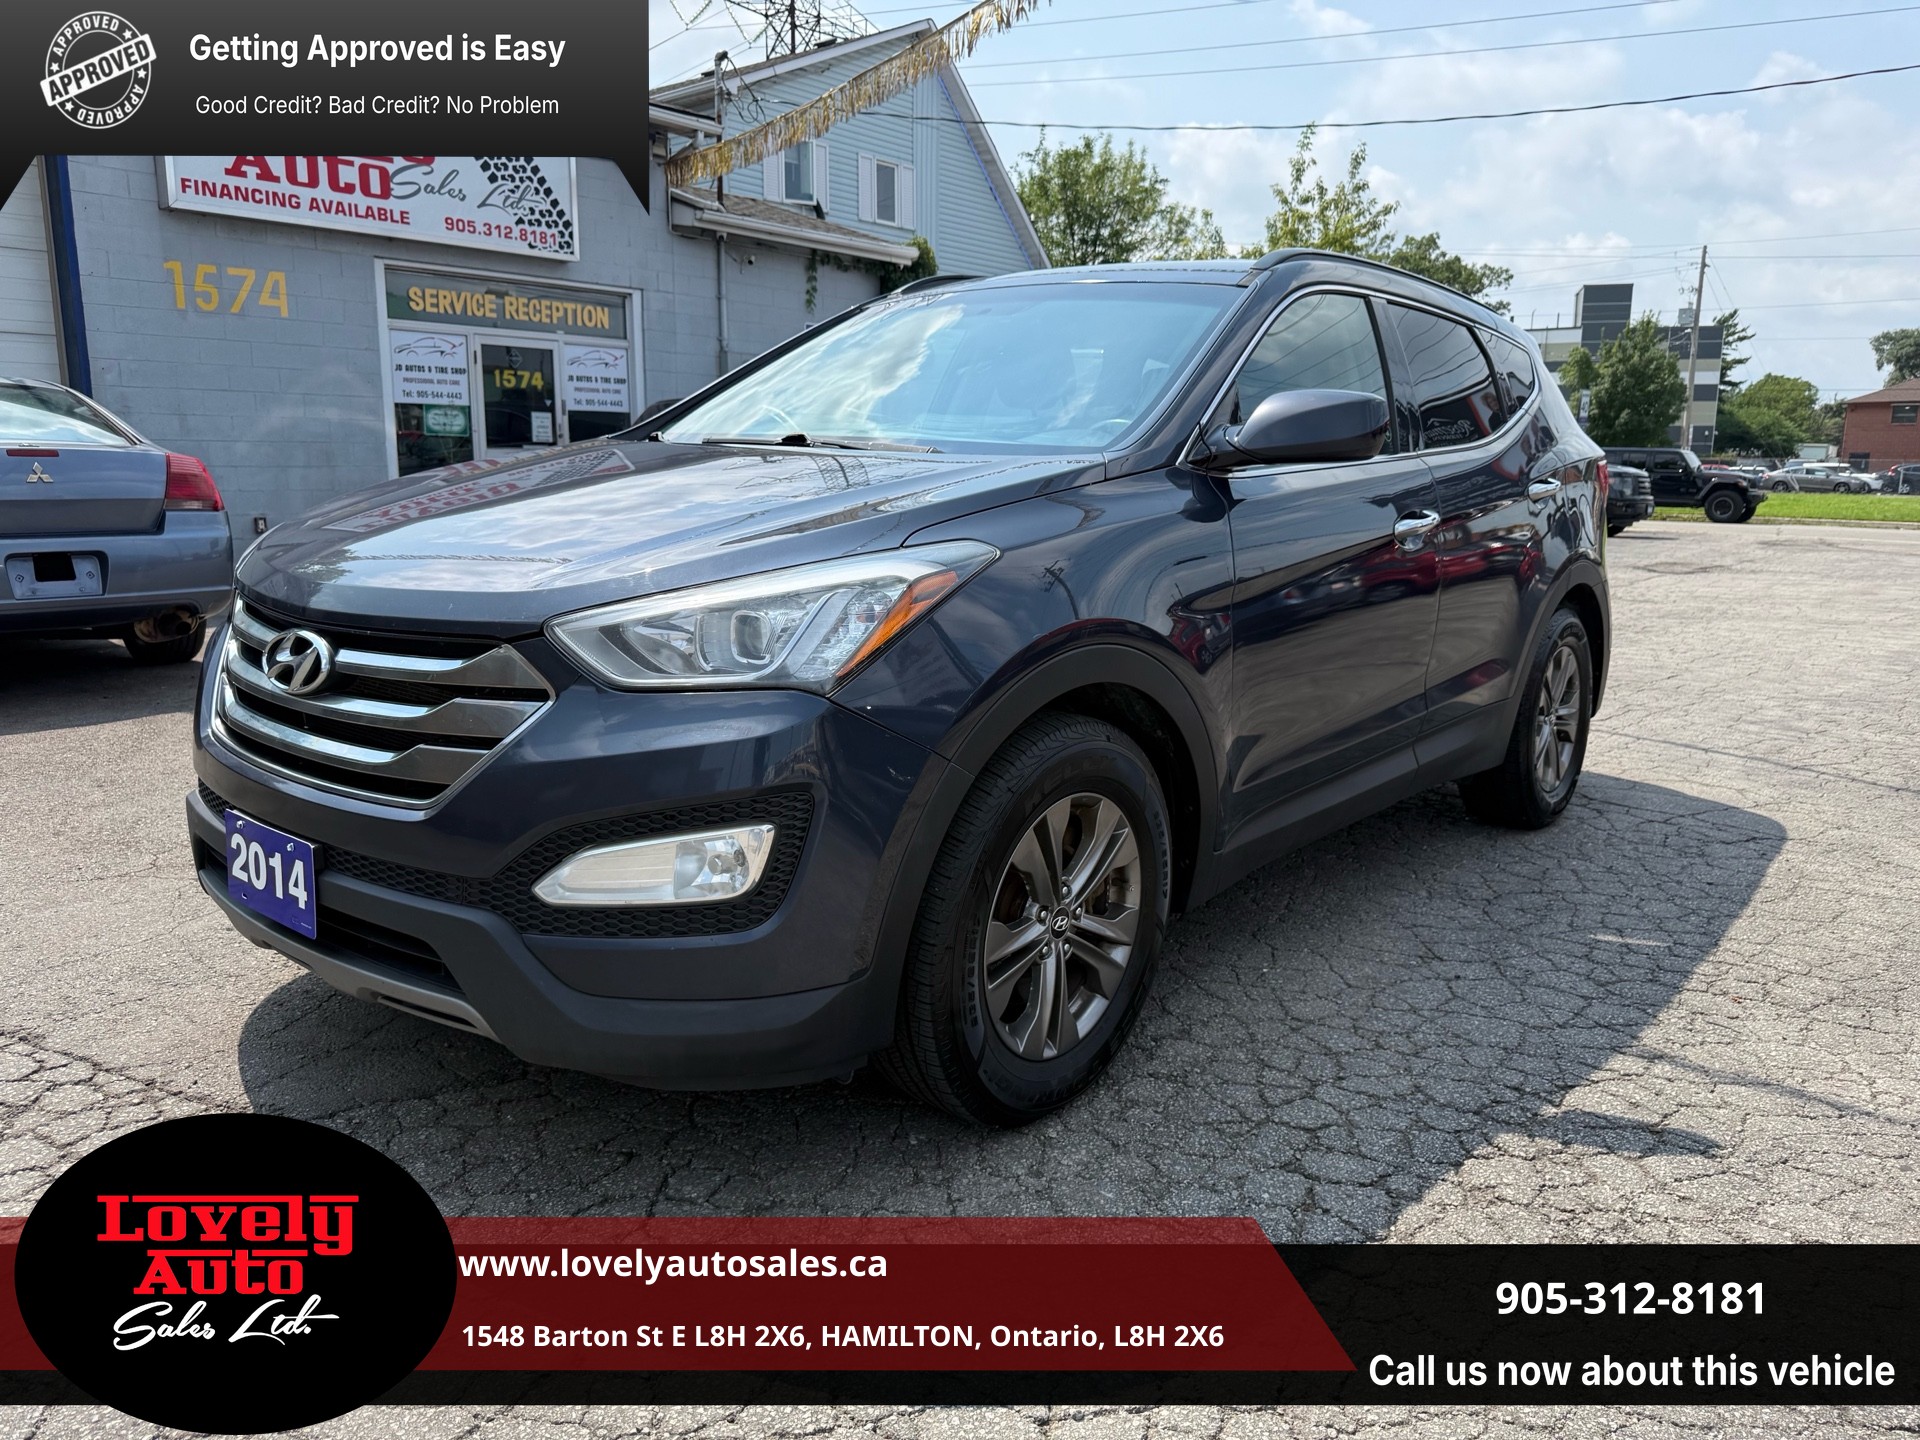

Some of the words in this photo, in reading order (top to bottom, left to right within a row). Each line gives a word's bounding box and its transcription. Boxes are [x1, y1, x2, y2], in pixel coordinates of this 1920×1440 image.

[390, 164, 467, 201] Sales
[180, 177, 301, 210] FINANCING
[308, 197, 411, 226] AVAILABLE
[444, 216, 558, 247] 905.312.8181
[163, 259, 289, 318] 1574
[407, 285, 498, 319] SERVICE
[503, 294, 610, 330] RECEPTION
[434, 366, 449, 375] TIRE
[450, 367, 467, 376] SHOP
[493, 369, 545, 390] 1574
[401, 389, 415, 398] Tel:
[416, 390, 463, 400] 905-544-4443
[230, 832, 308, 910] 2014
